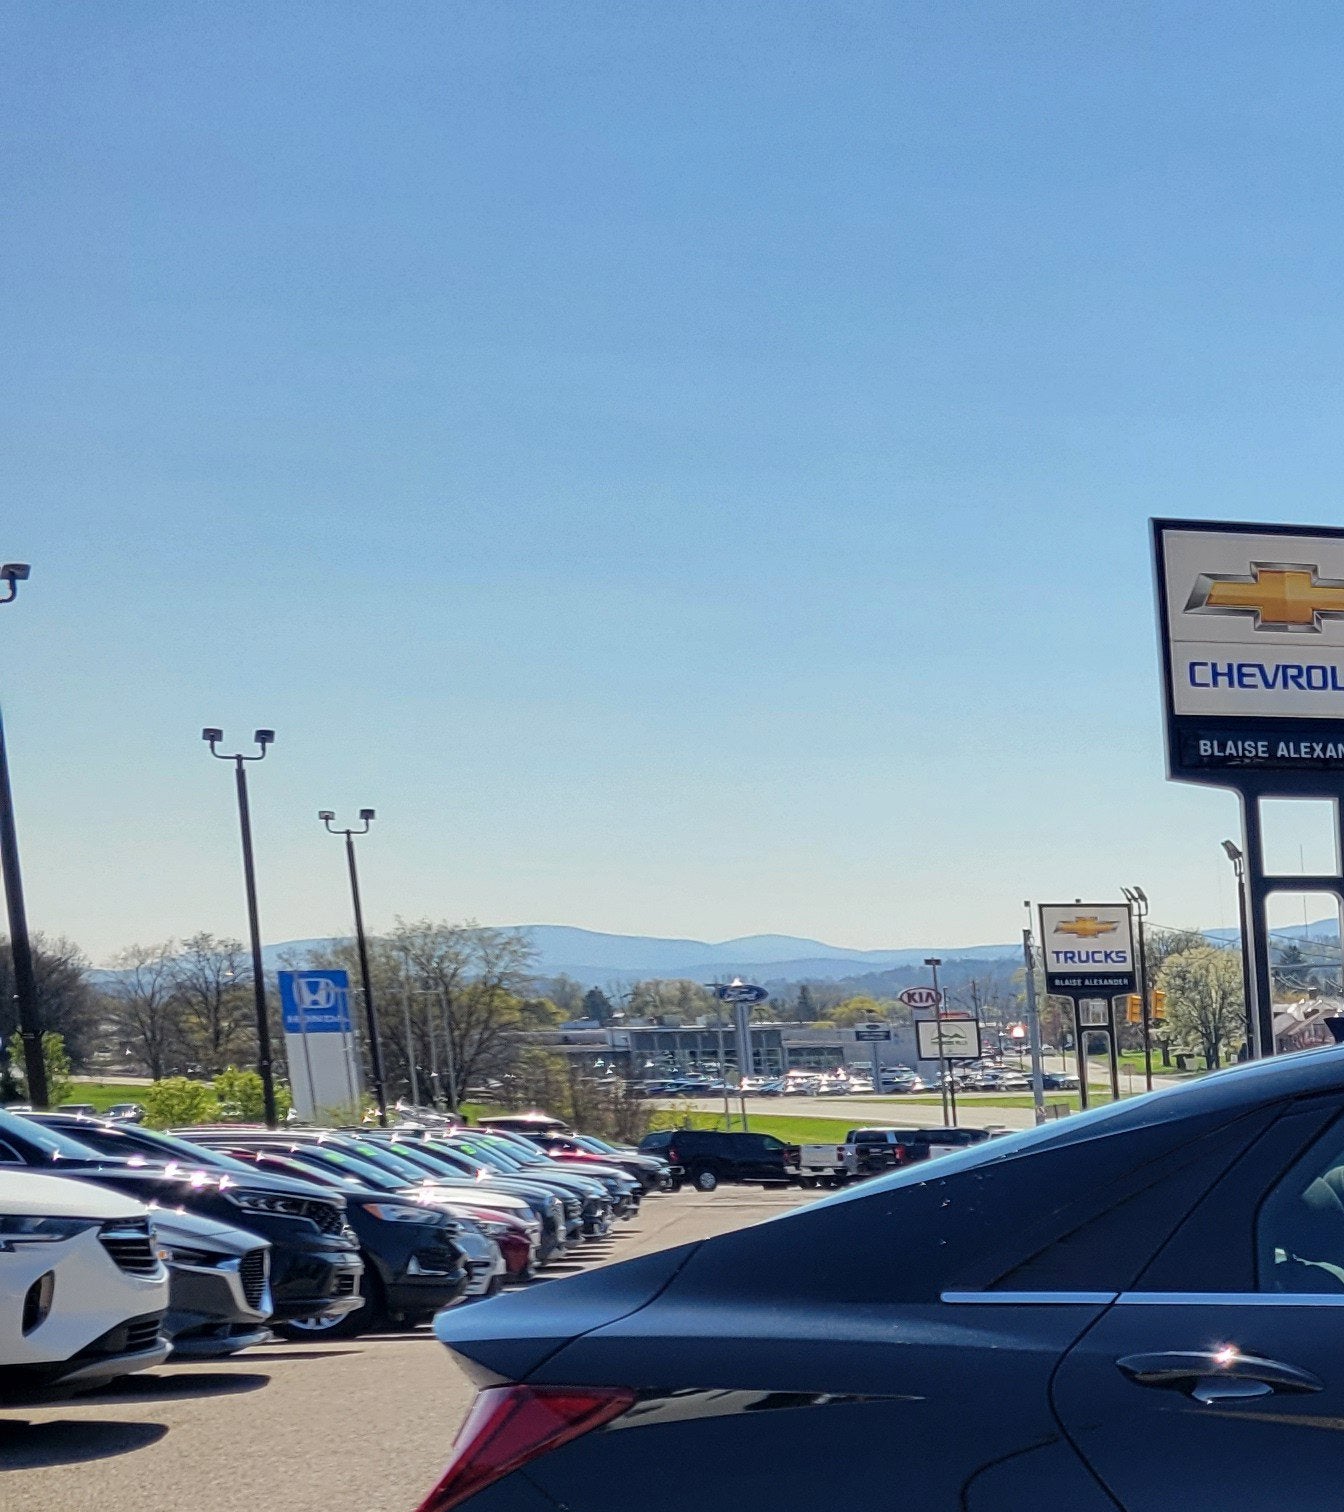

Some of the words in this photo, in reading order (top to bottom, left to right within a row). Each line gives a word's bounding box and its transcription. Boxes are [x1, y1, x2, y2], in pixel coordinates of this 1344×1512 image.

[1199, 739, 1269, 758] BLAISE
[1052, 950, 1128, 964] TRUCKS
[1083, 978, 1129, 986] ALEXANDER
[906, 991, 937, 1004] KIA
